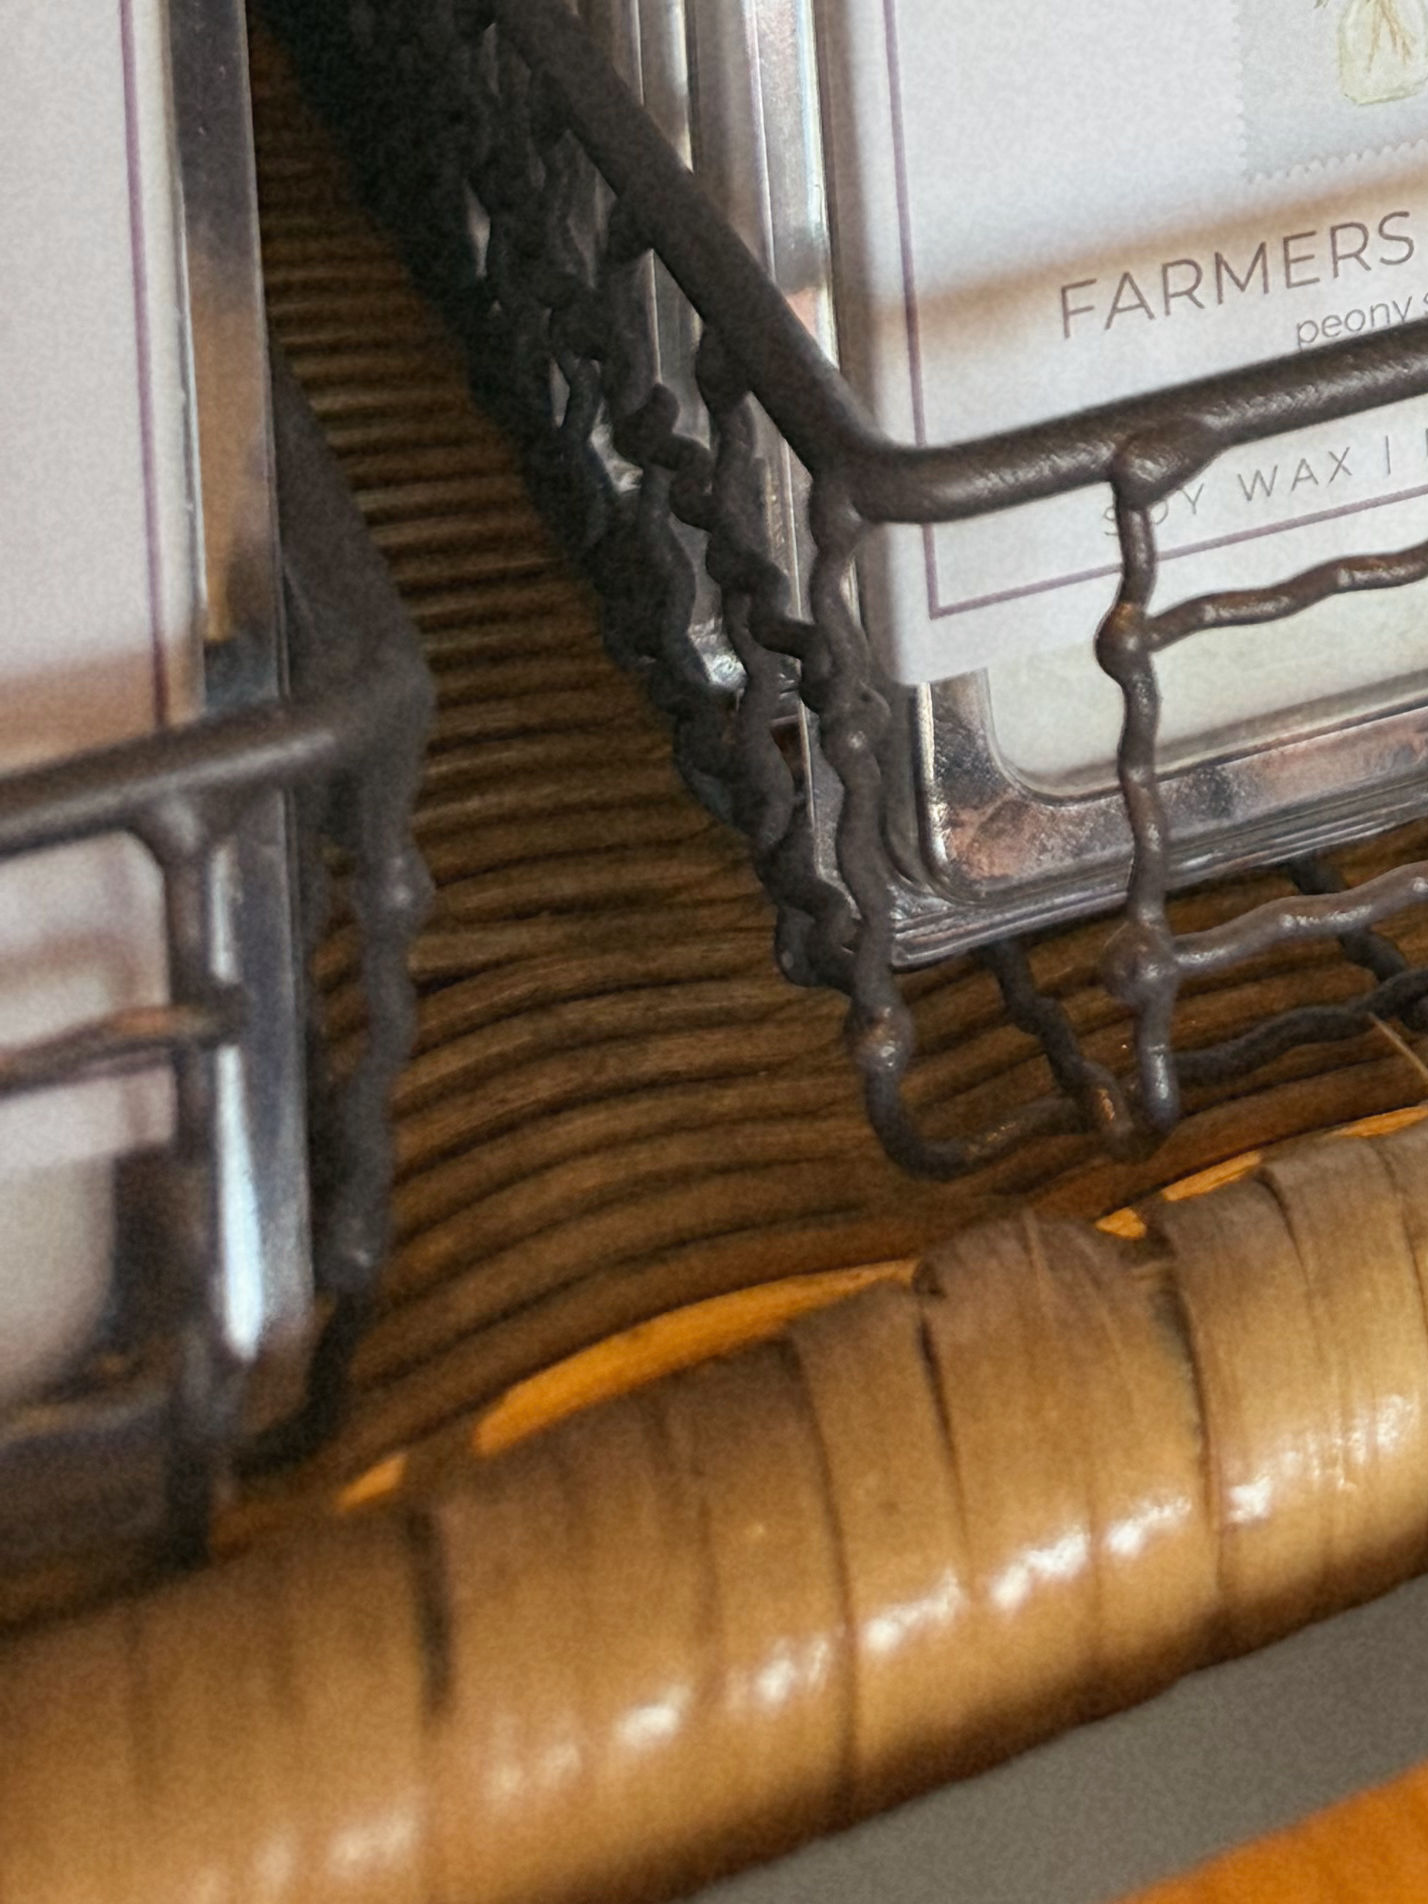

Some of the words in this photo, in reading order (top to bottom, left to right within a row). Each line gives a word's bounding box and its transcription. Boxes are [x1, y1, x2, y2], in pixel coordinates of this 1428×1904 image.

[1060, 209, 1416, 340] FARMERS
[1296, 294, 1414, 346] peony
[1236, 446, 1353, 502] WAX
